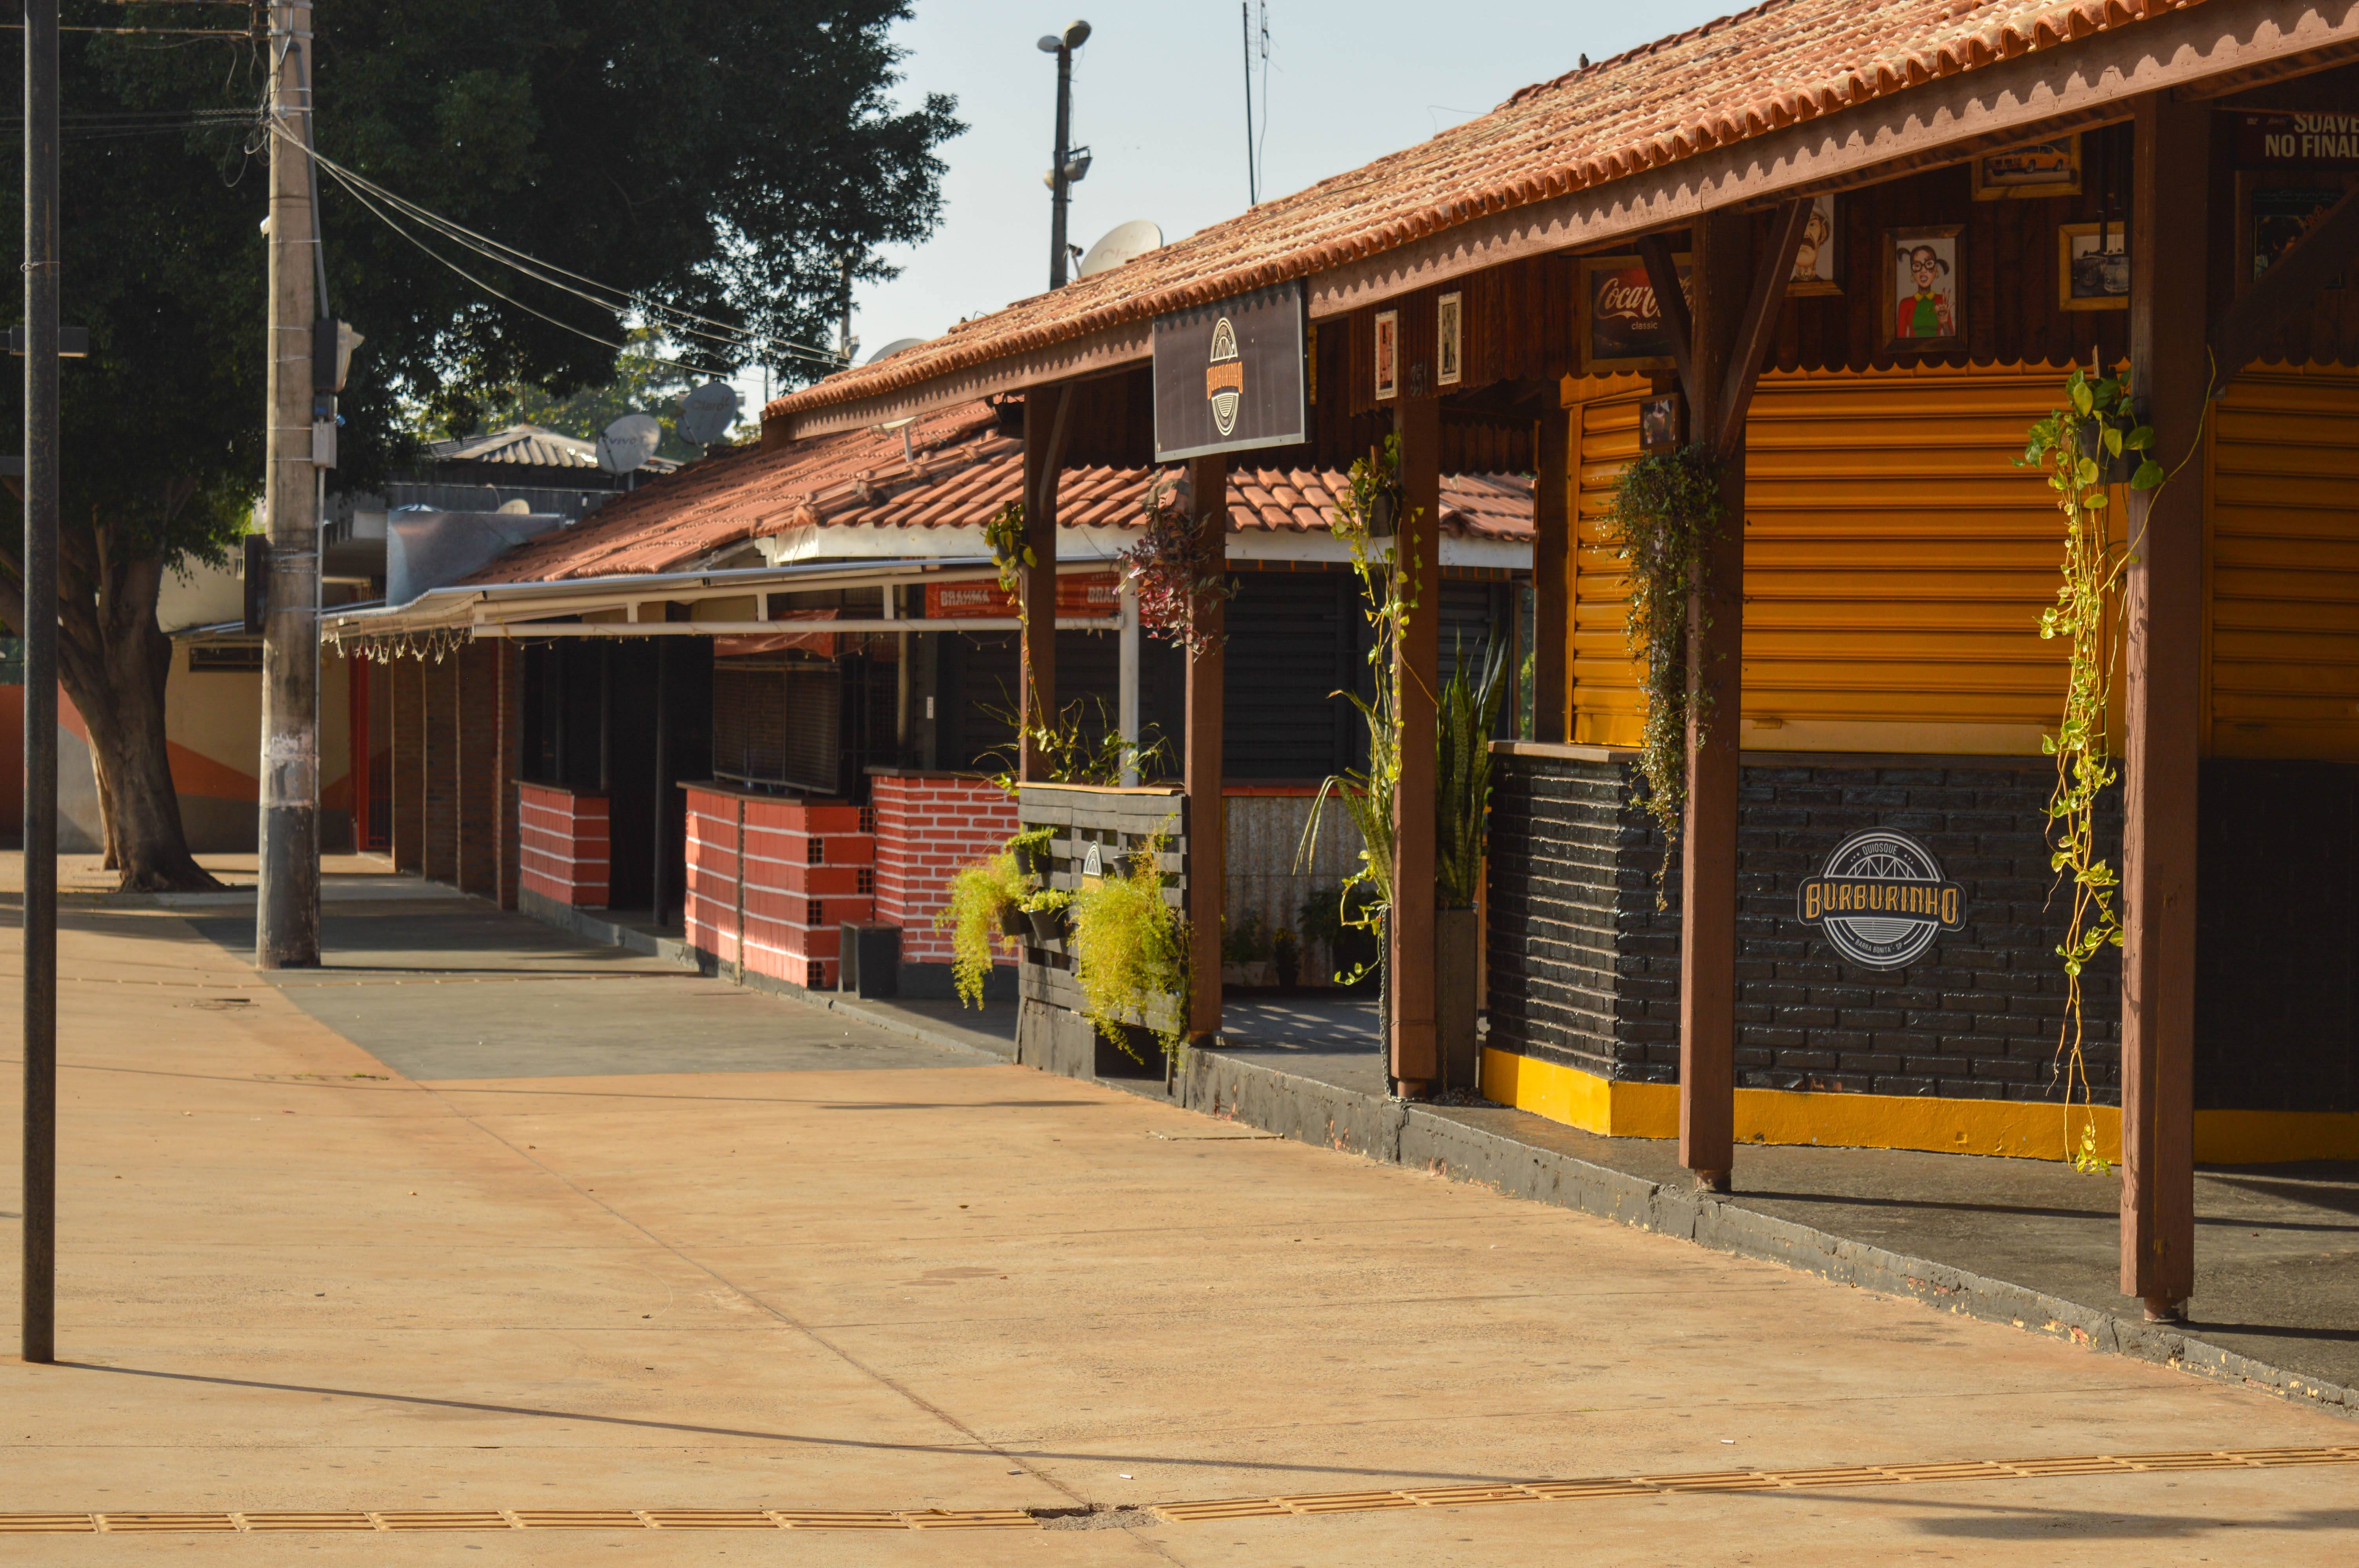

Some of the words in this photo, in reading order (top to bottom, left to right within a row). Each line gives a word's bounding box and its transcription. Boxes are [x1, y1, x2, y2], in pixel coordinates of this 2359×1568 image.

[2294, 114, 2359, 134] SUAVE
[2265, 134, 2295, 158] NO
[1631, 321, 1658, 330] classic
[941, 590, 990, 607] BRAHMA
[1862, 843, 1898, 856] QUIOSQUE
[1805, 883, 1958, 924] BURBURINHO
[1855, 939, 1872, 952] BARRA
[1896, 942, 1902, 951] SP
